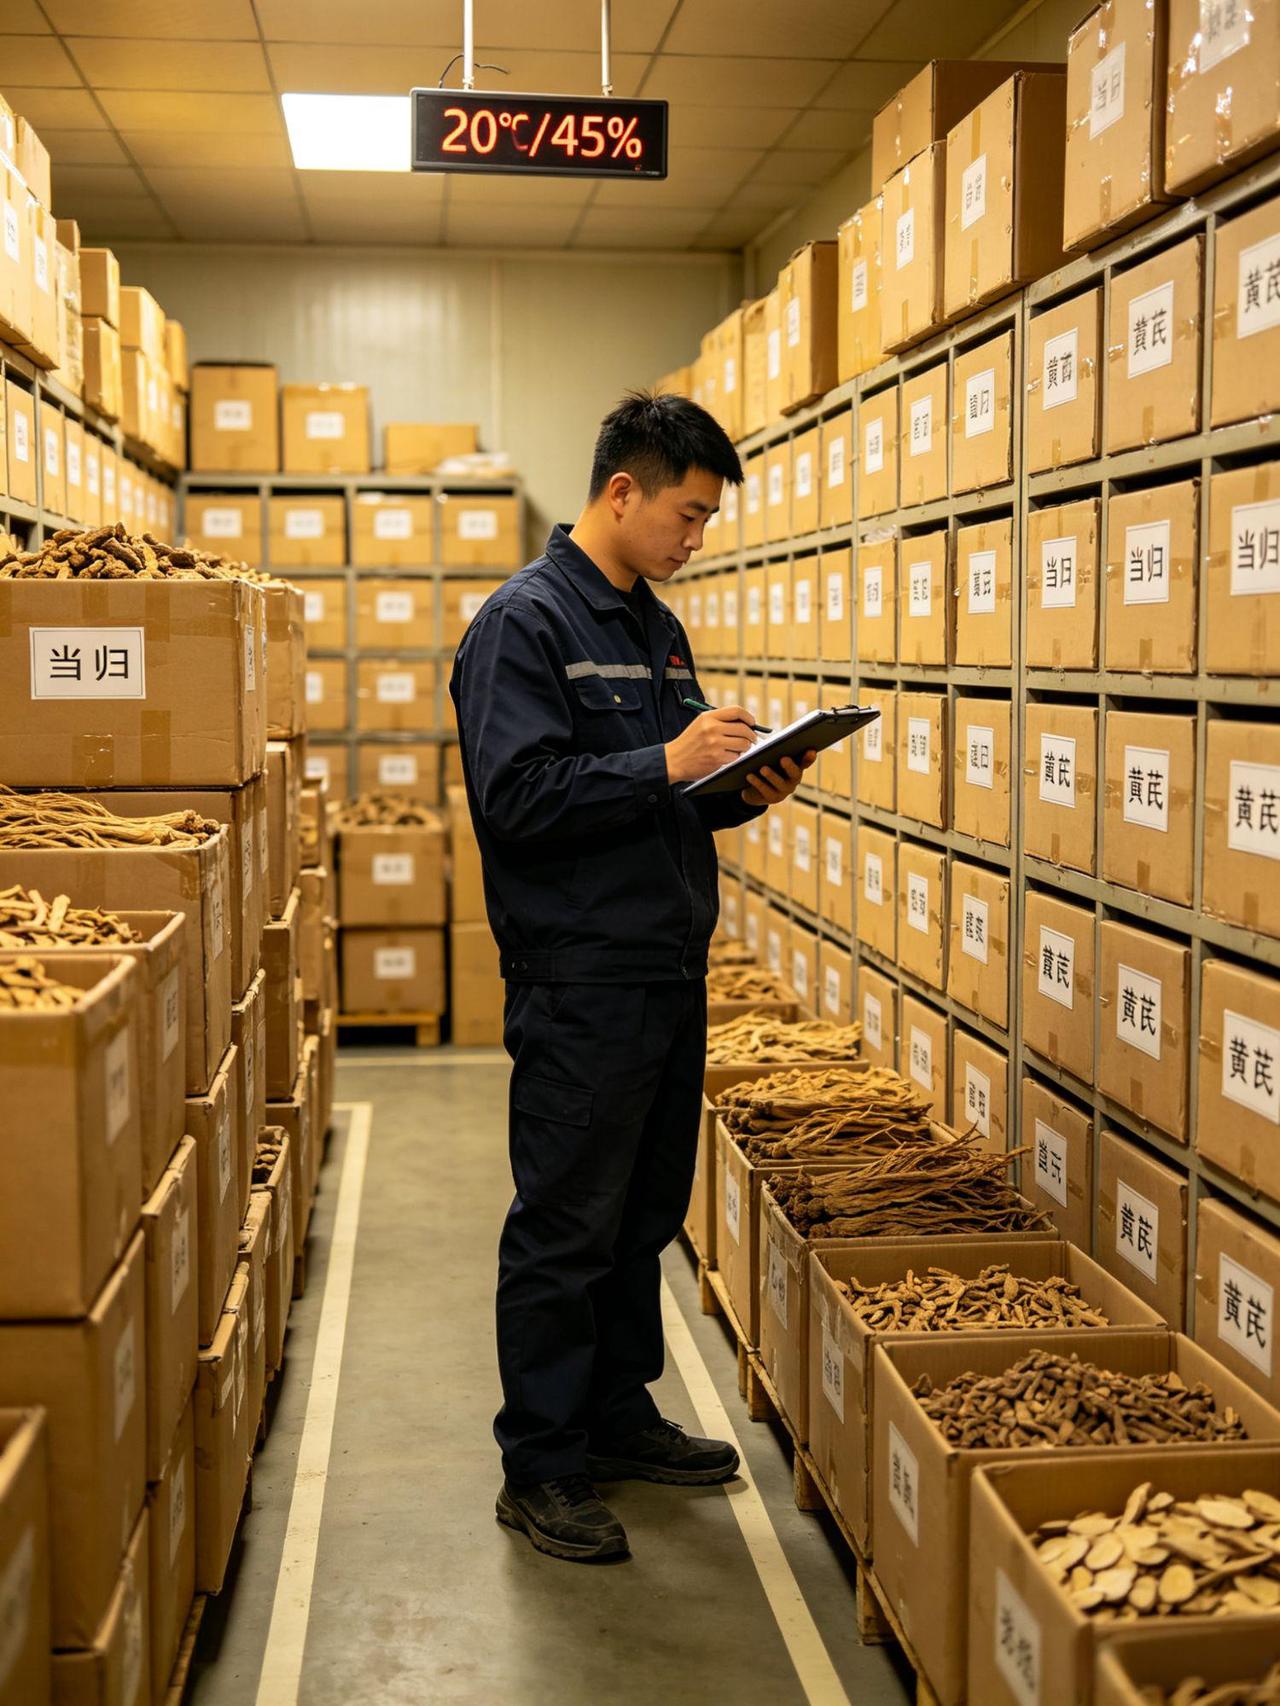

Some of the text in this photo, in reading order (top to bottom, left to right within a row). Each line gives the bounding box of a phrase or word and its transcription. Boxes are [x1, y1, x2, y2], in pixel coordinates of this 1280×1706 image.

[1133, 308, 1166, 356] 黄芪
[1130, 543, 1164, 582] 当归
[1238, 525, 1280, 570] 当归
[50, 644, 128, 680] 当归
[1128, 766, 1164, 810] 黄芪
[1235, 786, 1280, 835] 黄芪
[1122, 986, 1156, 1036] 黄芪
[1229, 1037, 1274, 1097] 黄芪
[1120, 1202, 1152, 1260] 黄芪
[1223, 1278, 1267, 1349] 黄芪
